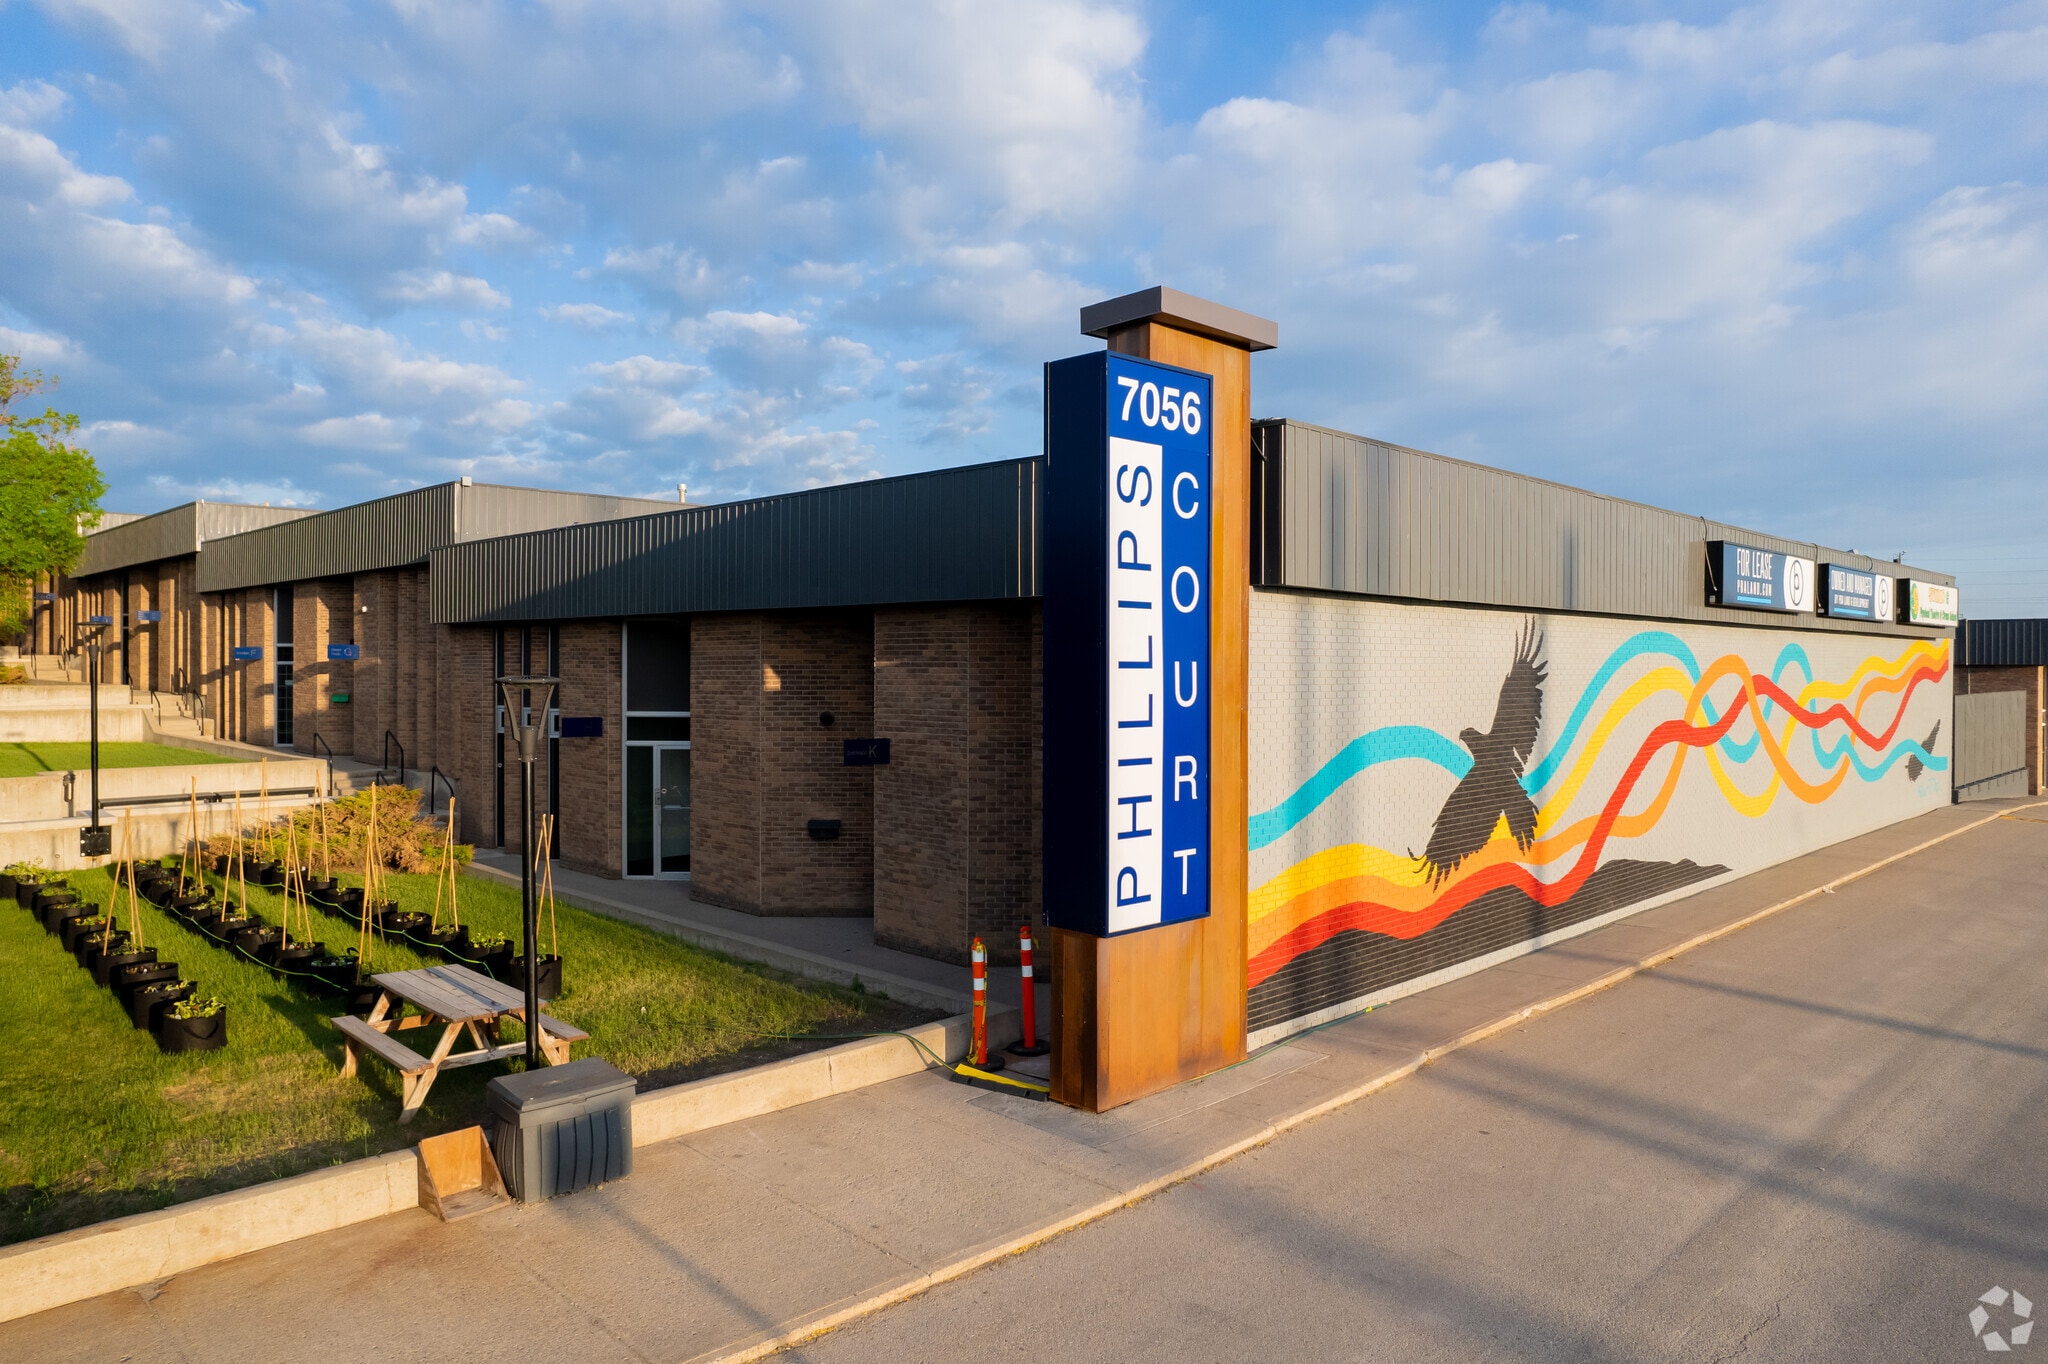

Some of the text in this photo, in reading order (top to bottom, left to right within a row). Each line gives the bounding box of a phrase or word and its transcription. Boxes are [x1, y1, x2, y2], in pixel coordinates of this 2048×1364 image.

[1117, 376, 1201, 435] 7056
[1737, 548, 1772, 580] FOR LEASE
[1831, 570, 1873, 596] OWNED AND MANAGED
[1116, 464, 1152, 906] PHILLIPS
[1171, 472, 1200, 894] COURT
[868, 744, 878, 759] K
